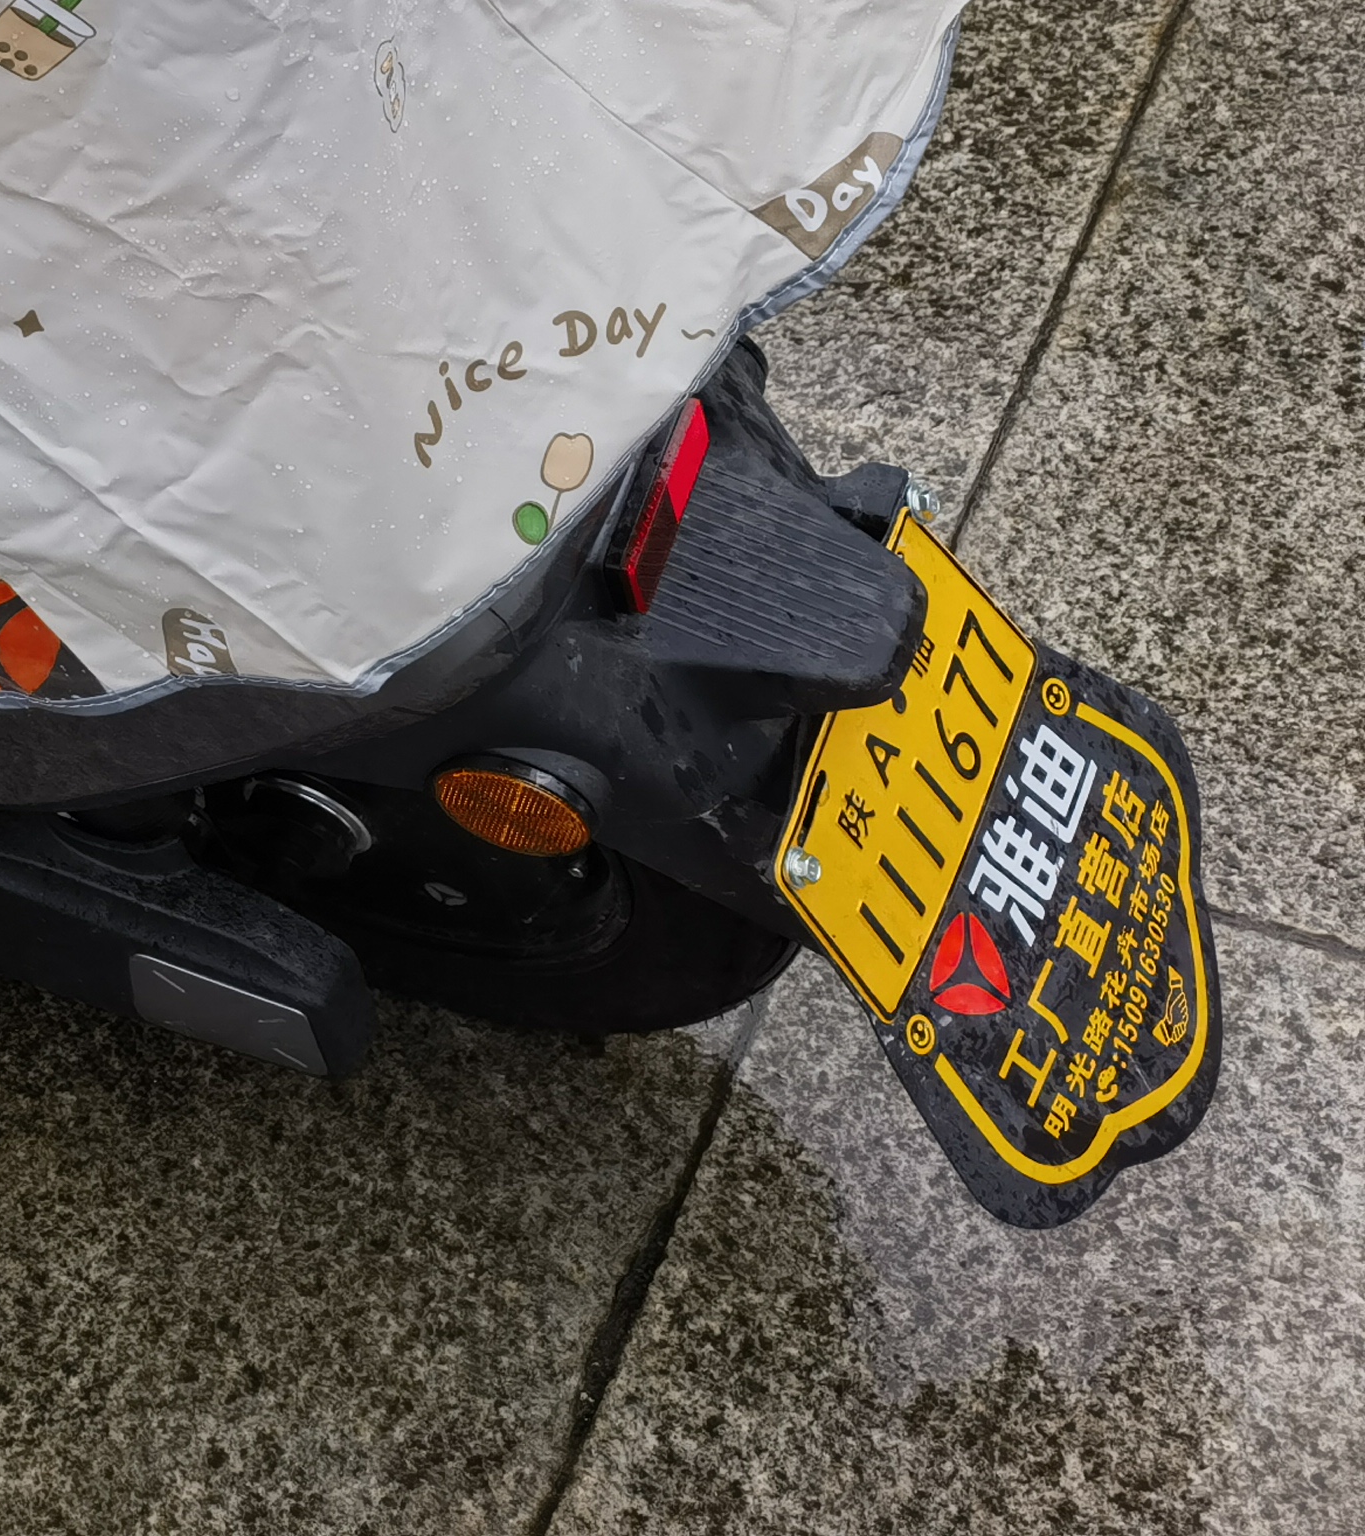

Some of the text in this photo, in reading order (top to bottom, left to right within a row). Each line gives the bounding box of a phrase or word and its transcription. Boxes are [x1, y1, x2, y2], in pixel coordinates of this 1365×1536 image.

[784, 155, 883, 232] Day
[413, 302, 668, 470] Nice Day
[858, 607, 1015, 966] 1111677
[969, 723, 1098, 948] 雅迪
[978, 769, 1148, 1109] 工厂直营店
[1042, 798, 1171, 1140] 明光路花卉市场店
